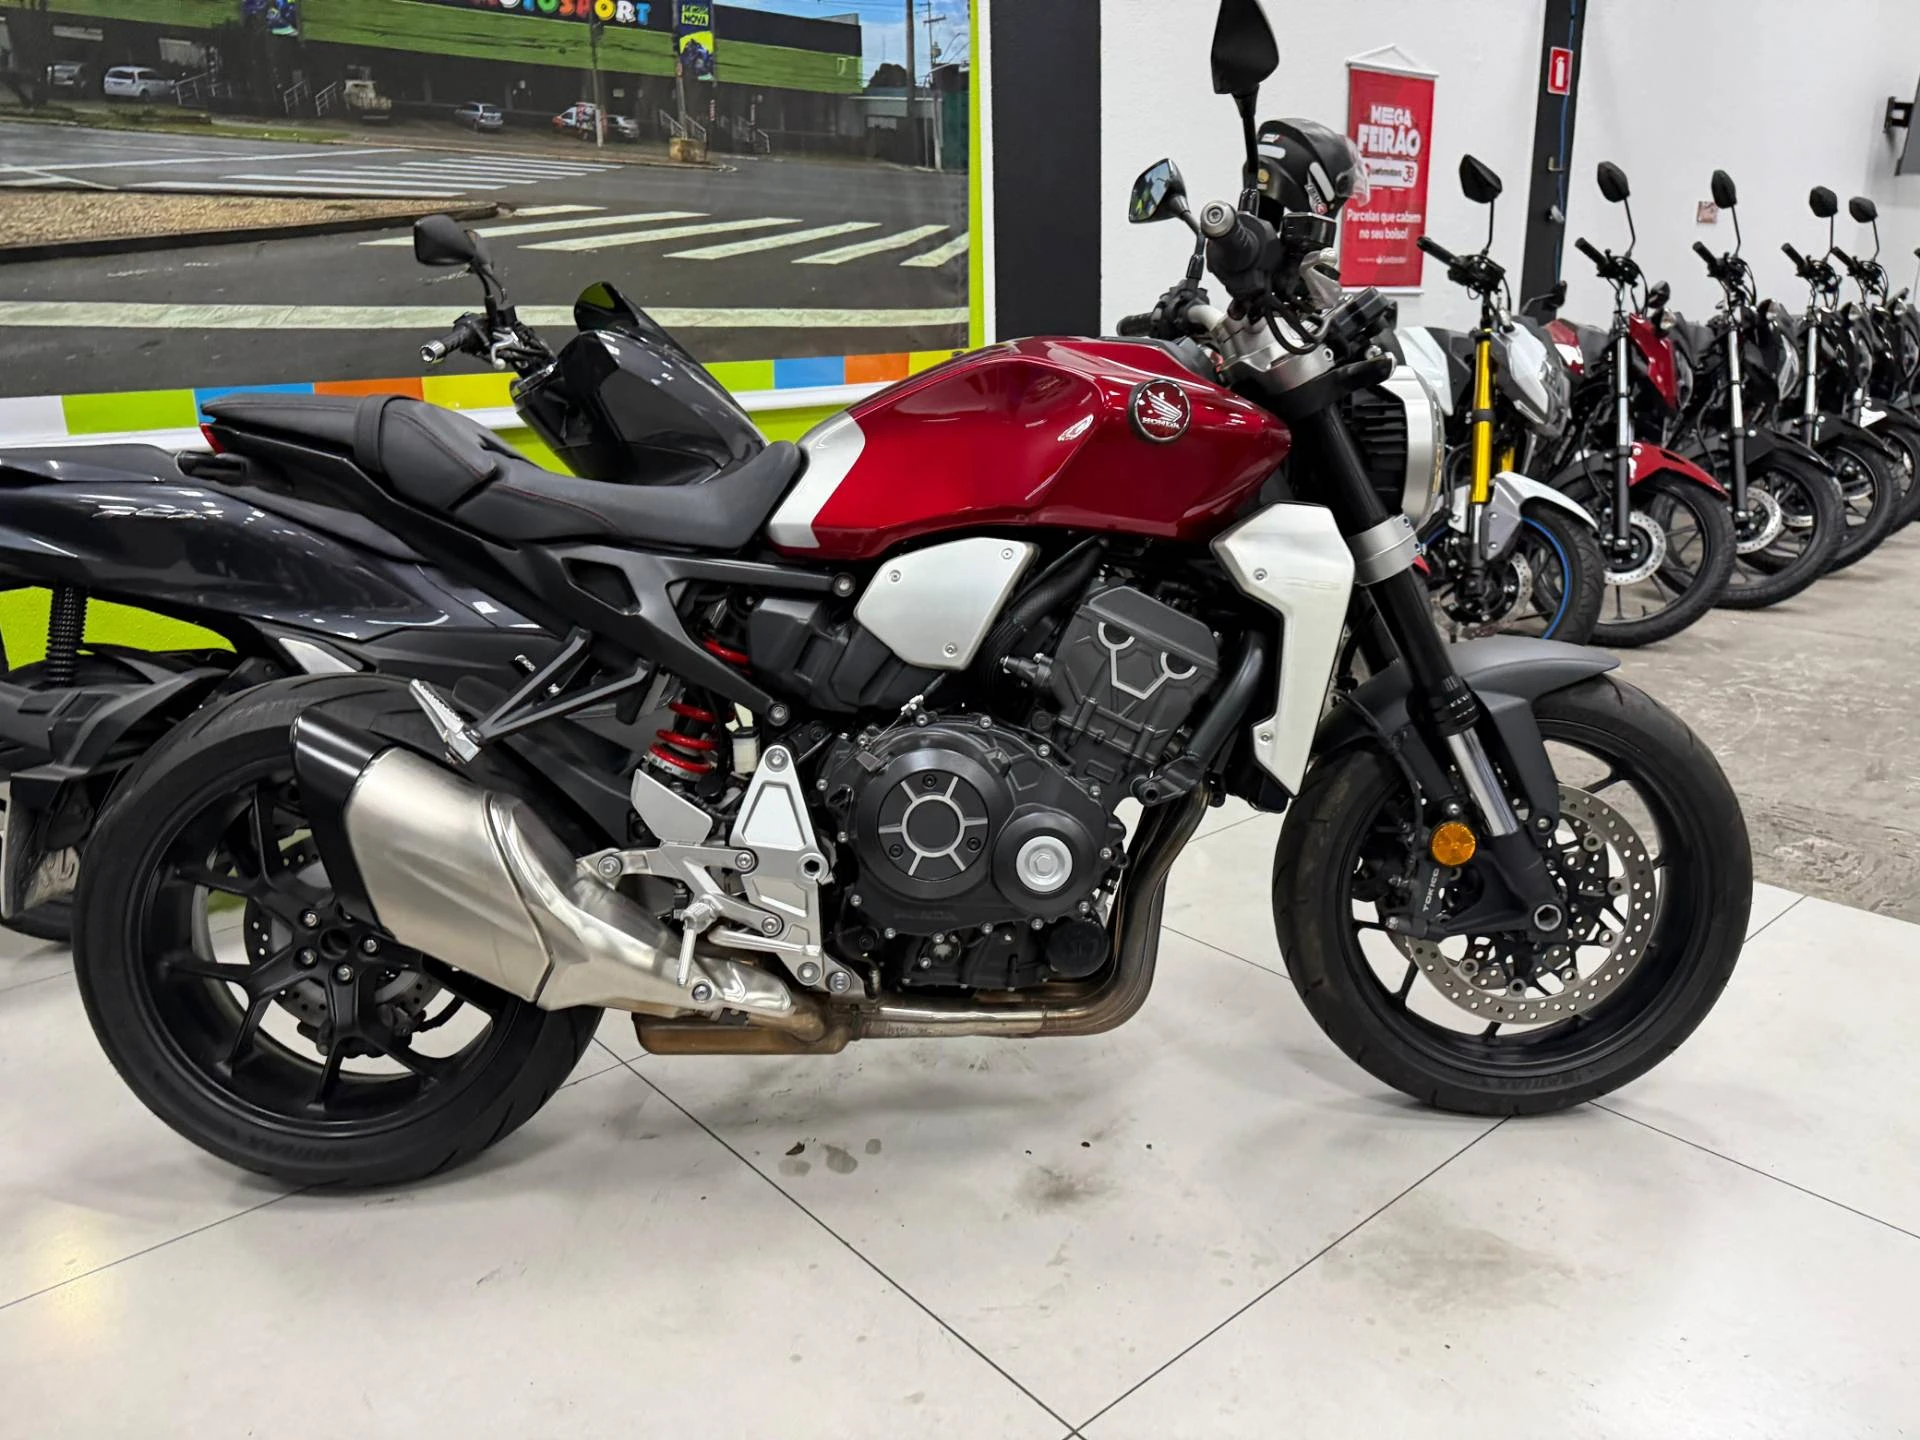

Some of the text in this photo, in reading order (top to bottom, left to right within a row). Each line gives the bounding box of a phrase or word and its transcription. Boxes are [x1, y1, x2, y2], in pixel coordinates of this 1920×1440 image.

[473, 0, 651, 25] OSPORT
[1371, 105, 1412, 128] MEGA
[1347, 208, 1422, 225] Parcelas que cabem
[1359, 229, 1370, 240] no
[1370, 229, 1384, 240] seu
[1142, 416, 1180, 430] HONDA
[1422, 867, 1440, 912] TOKICO
